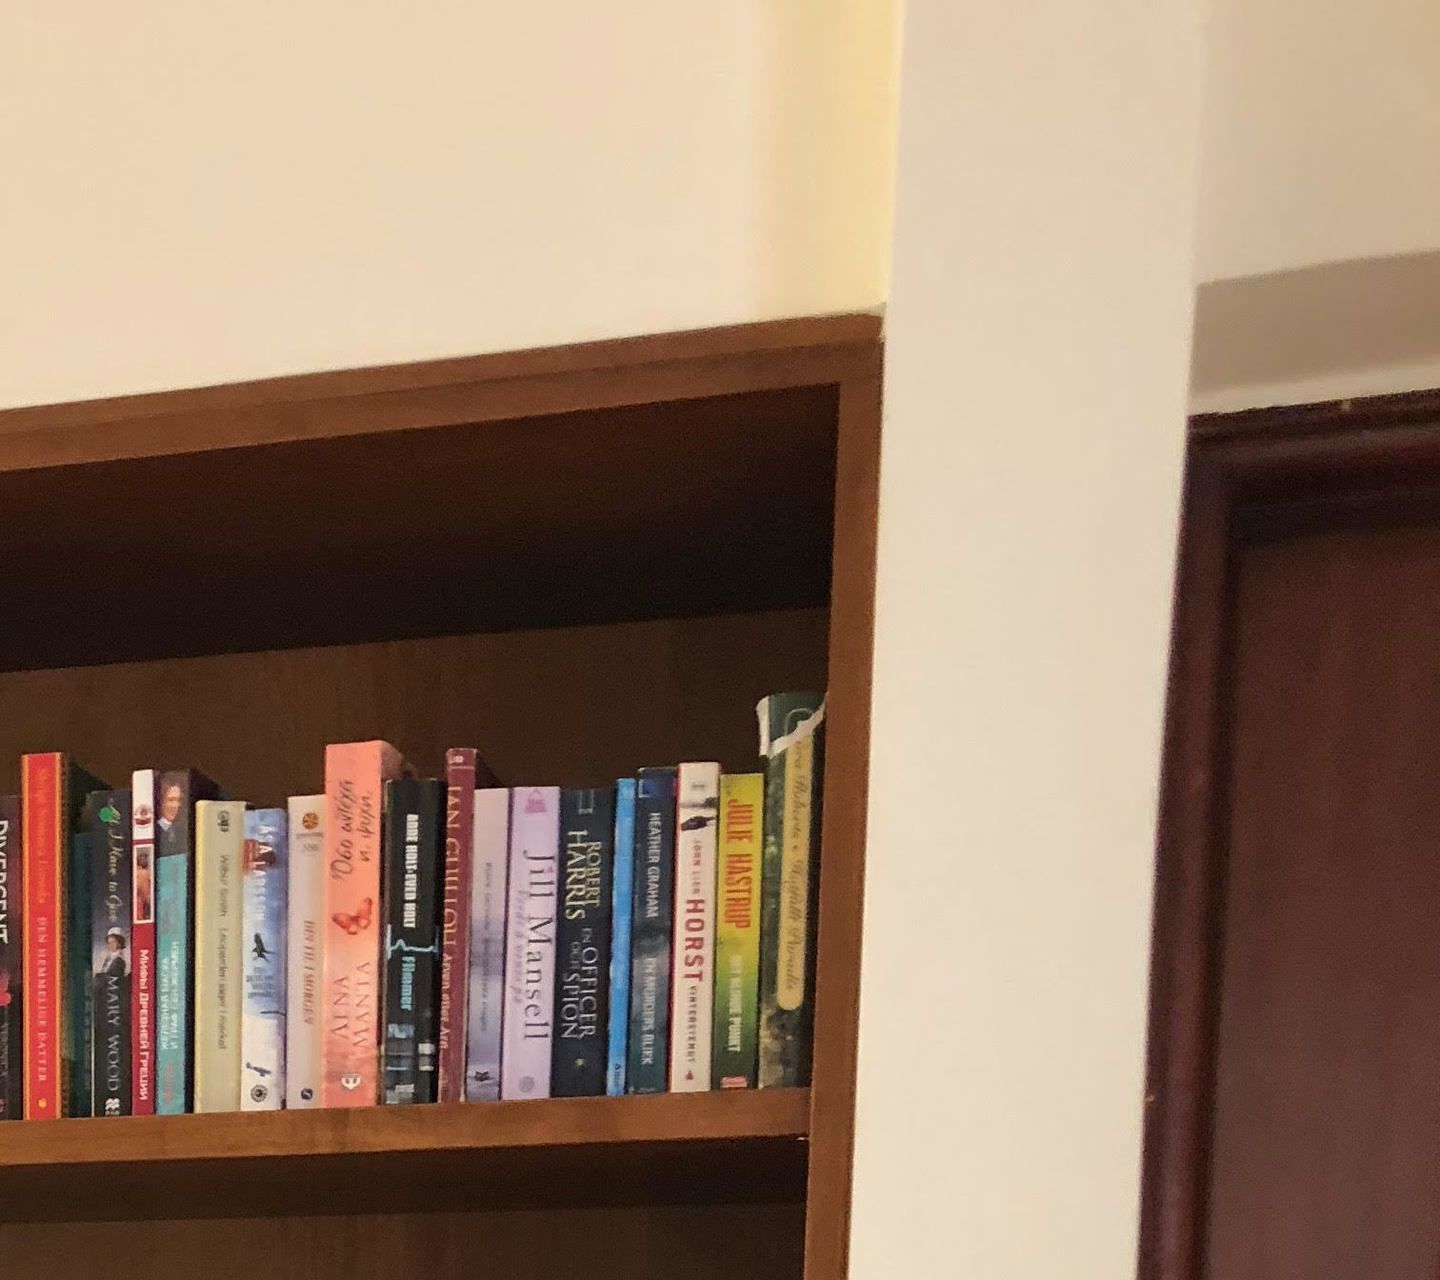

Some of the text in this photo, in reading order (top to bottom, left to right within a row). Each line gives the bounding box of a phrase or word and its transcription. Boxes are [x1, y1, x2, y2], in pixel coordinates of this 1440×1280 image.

[565, 830, 589, 920] HARRIS
[586, 840, 603, 908] ROBERT
[646, 813, 661, 918] HEATHER GRAHAM
[724, 799, 754, 929] JULIE HASTRUP
[400, 956, 415, 1011] Flimmer
[523, 850, 555, 1041] Jill Mansell
[578, 928, 599, 1039] EN OFFICER
[683, 898, 706, 982] HORST
[106, 976, 121, 1091] MARY WOOD
[138, 949, 151, 1100] МИФЫ ДРЕВНЕЙ ГРЕЦИИ
[561, 972, 581, 1039] SPION
